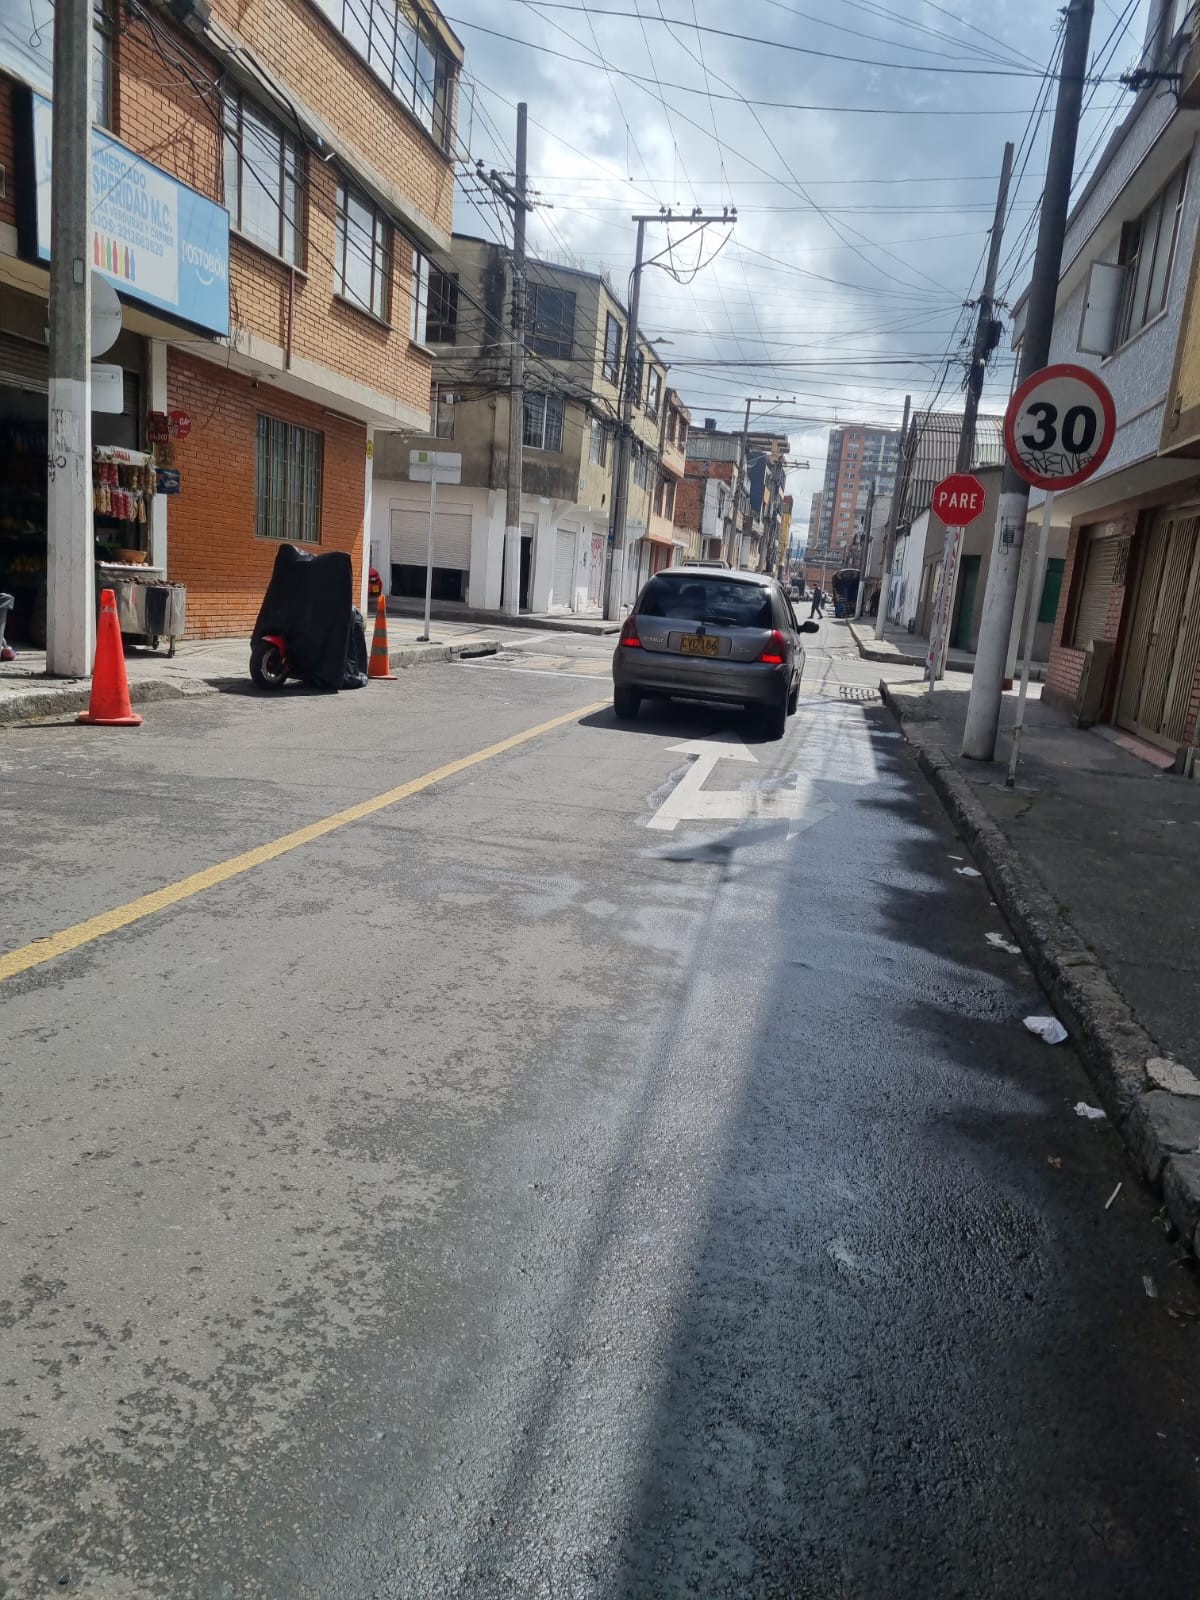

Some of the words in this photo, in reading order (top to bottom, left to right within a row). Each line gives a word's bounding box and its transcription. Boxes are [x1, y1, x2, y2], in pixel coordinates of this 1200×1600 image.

[92, 164, 149, 219] SPERIDAD
[92, 208, 116, 233] LIOS:
[1021, 402, 1097, 454] 30
[938, 491, 978, 509] PARE
